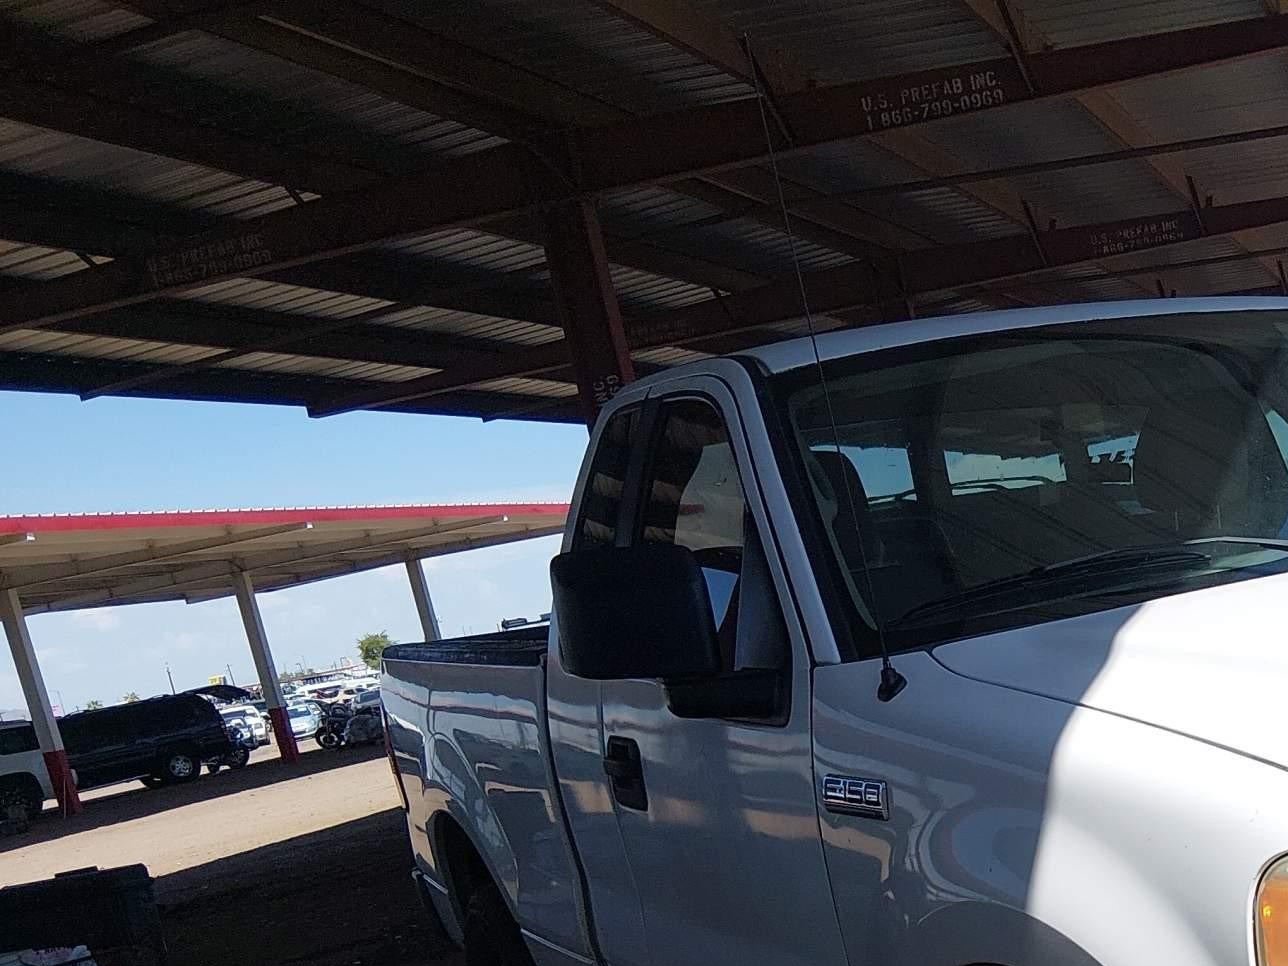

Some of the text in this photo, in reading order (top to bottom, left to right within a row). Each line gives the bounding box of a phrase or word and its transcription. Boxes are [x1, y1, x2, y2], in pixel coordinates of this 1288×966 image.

[860, 71, 1001, 113] U.S. PREFAB INC.
[879, 88, 1005, 128] 866-799-0969
